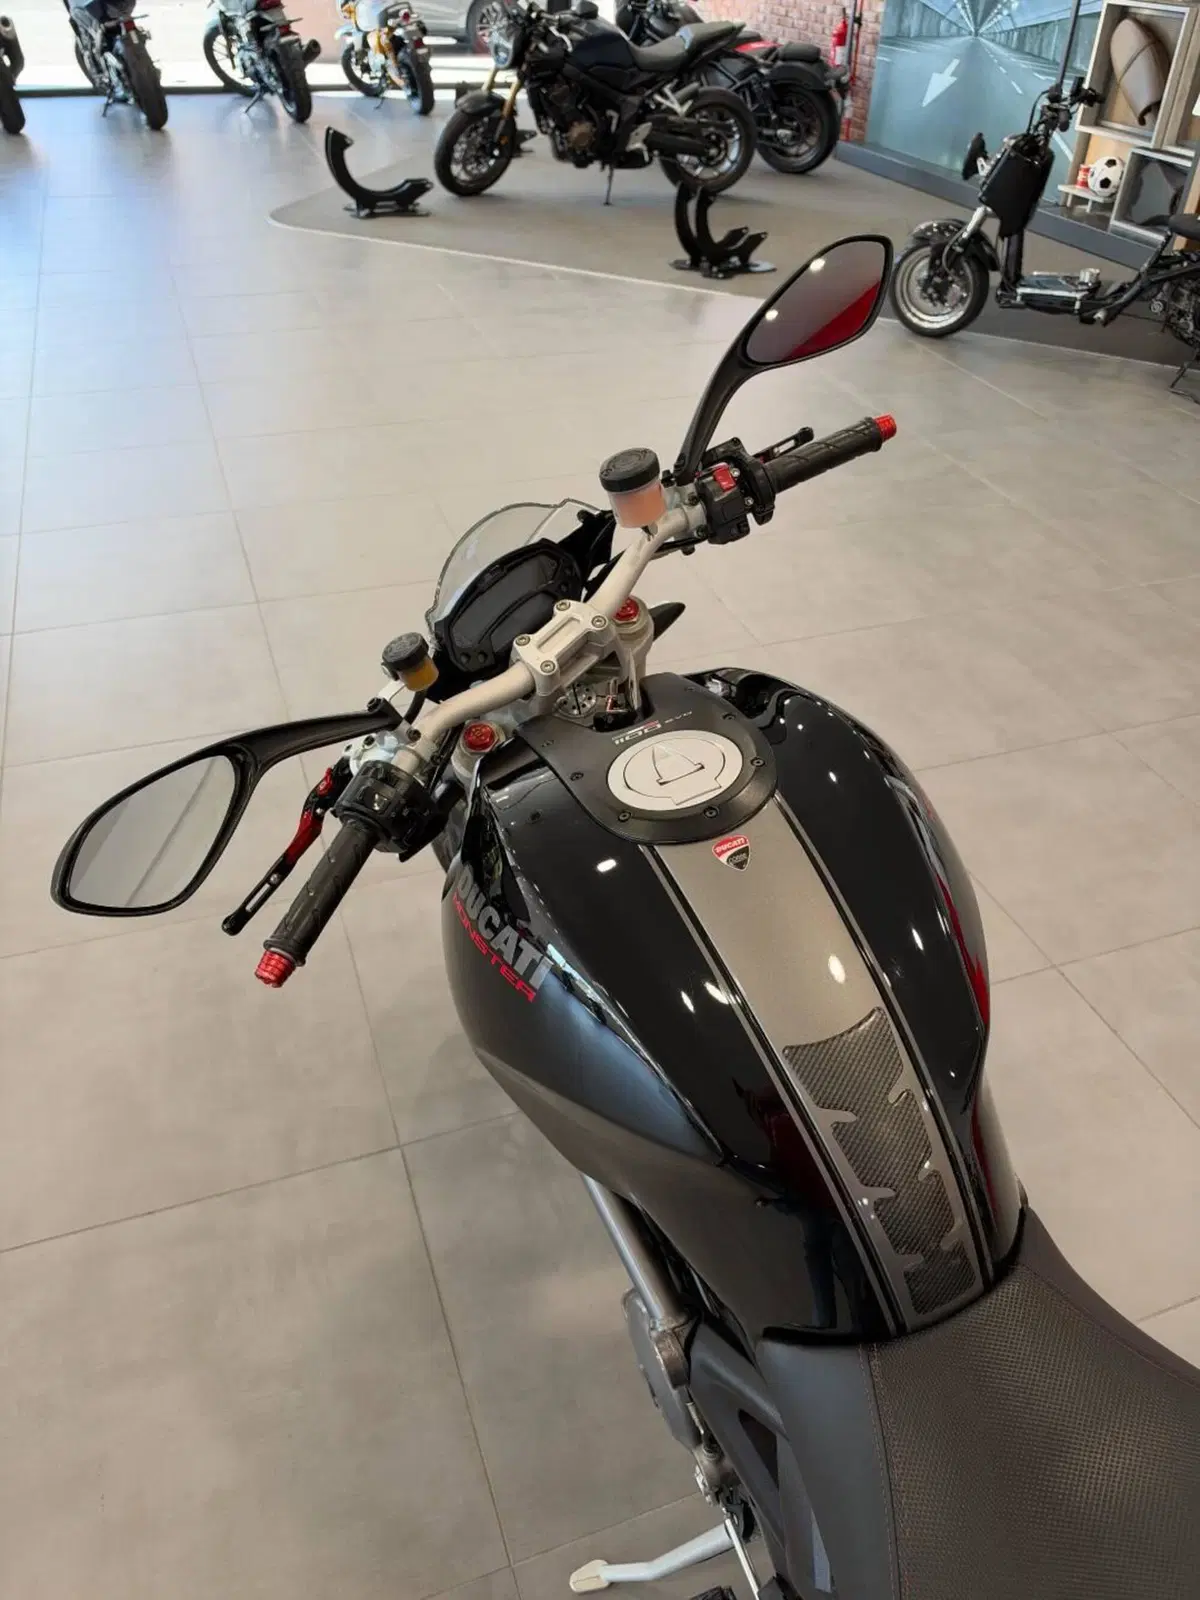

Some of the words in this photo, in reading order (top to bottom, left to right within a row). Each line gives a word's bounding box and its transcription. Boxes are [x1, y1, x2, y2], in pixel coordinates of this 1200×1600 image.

[715, 837, 746, 853] DUCATI
[453, 887, 536, 1002] MONSTER
[457, 862, 555, 990] DUCATI
